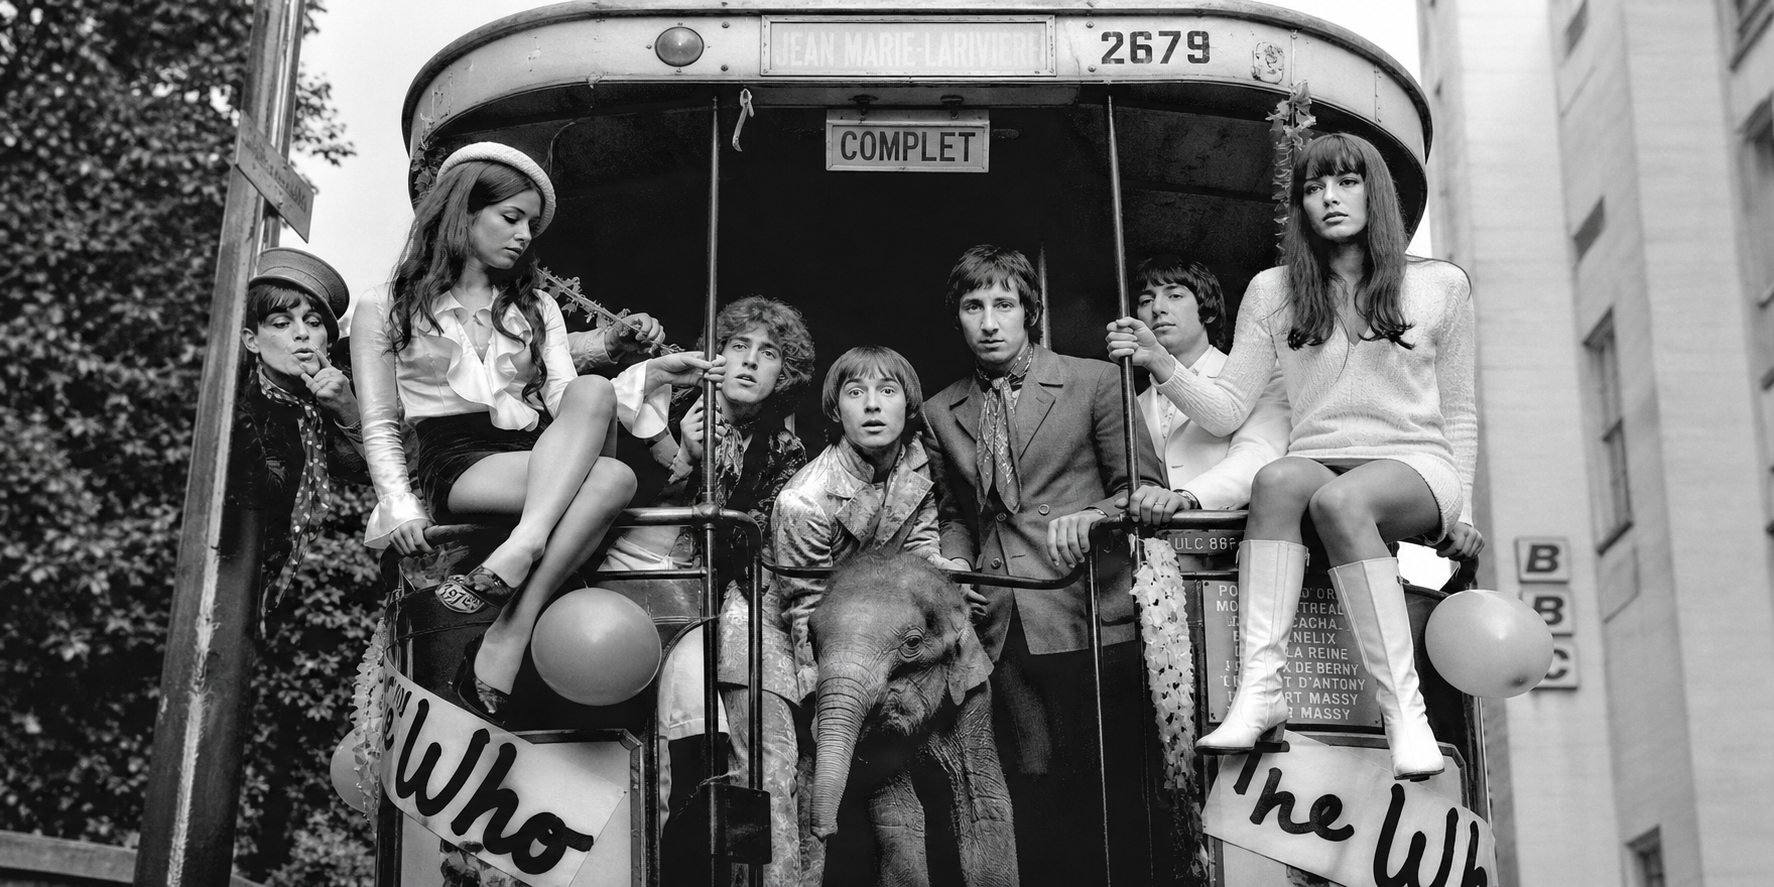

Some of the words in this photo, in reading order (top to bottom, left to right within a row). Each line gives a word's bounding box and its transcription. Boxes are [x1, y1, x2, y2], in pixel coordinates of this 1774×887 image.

[775, 30, 834, 67] JEAN
[1101, 30, 1210, 65] 2679
[840, 130, 977, 163] COMPLET
[1174, 537, 1203, 550] ULC
[1308, 646, 1349, 660] REINE
[1295, 661, 1313, 674] DE
[1316, 661, 1359, 676] BERNY
[1298, 676, 1366, 691] D'ANTONY
[1309, 691, 1358, 706] MASSY
[1300, 706, 1351, 720] MASSY
[395, 698, 594, 875] Who
[1232, 740, 1355, 842] The
[1373, 782, 1489, 887] Wh
